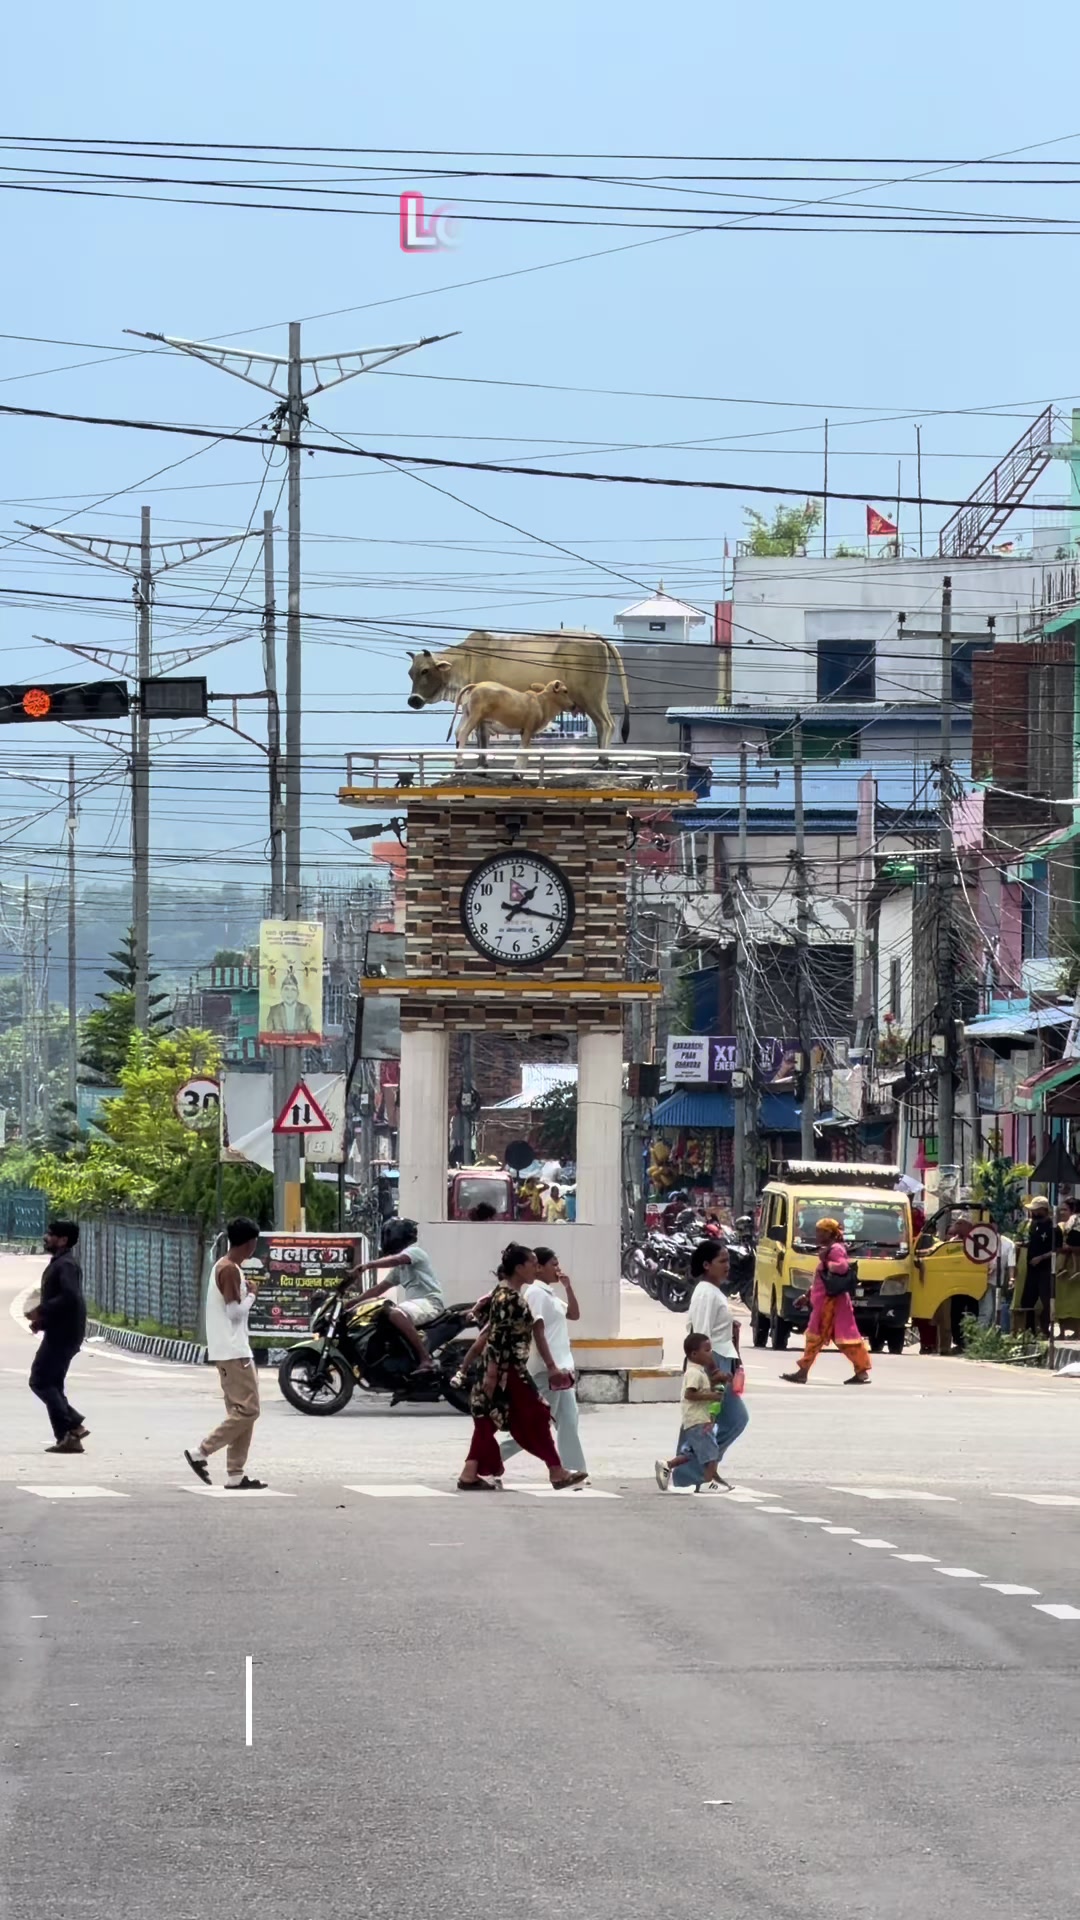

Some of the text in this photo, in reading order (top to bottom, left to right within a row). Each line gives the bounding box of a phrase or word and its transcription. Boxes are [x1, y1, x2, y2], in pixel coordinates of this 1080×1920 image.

[493, 870, 504, 882] 11
[512, 865, 525, 878] 12
[534, 871, 539, 883] 1
[480, 883, 493, 896] 10
[545, 883, 554, 895] 2
[473, 903, 482, 915] 9
[552, 903, 560, 915] 3
[480, 922, 488, 935] 8
[545, 922, 554, 934] 4
[494, 936, 503, 948] 7
[512, 940, 520, 952] 6
[532, 935, 540, 948] 5
[973, 1233, 989, 1258] P
